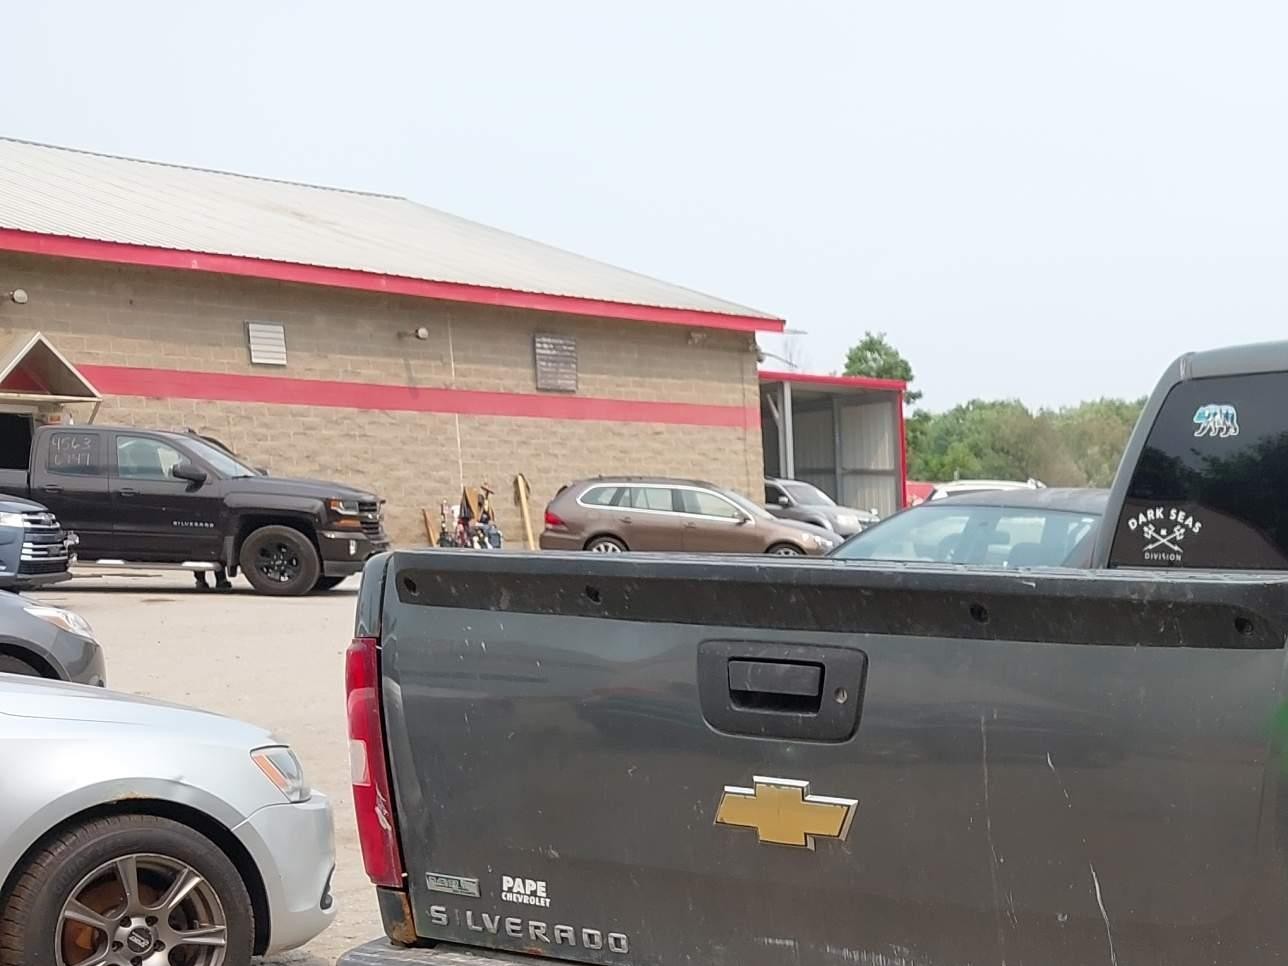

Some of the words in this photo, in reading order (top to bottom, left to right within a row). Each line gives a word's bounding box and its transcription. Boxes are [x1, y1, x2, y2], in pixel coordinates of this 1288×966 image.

[1127, 506, 1165, 531] DARK
[1169, 507, 1202, 533] SEAS
[1144, 551, 1182, 561] DIVISION
[502, 875, 548, 898] PAPE
[501, 892, 551, 908] CHEVROLET
[430, 905, 629, 954] SLVERADO
